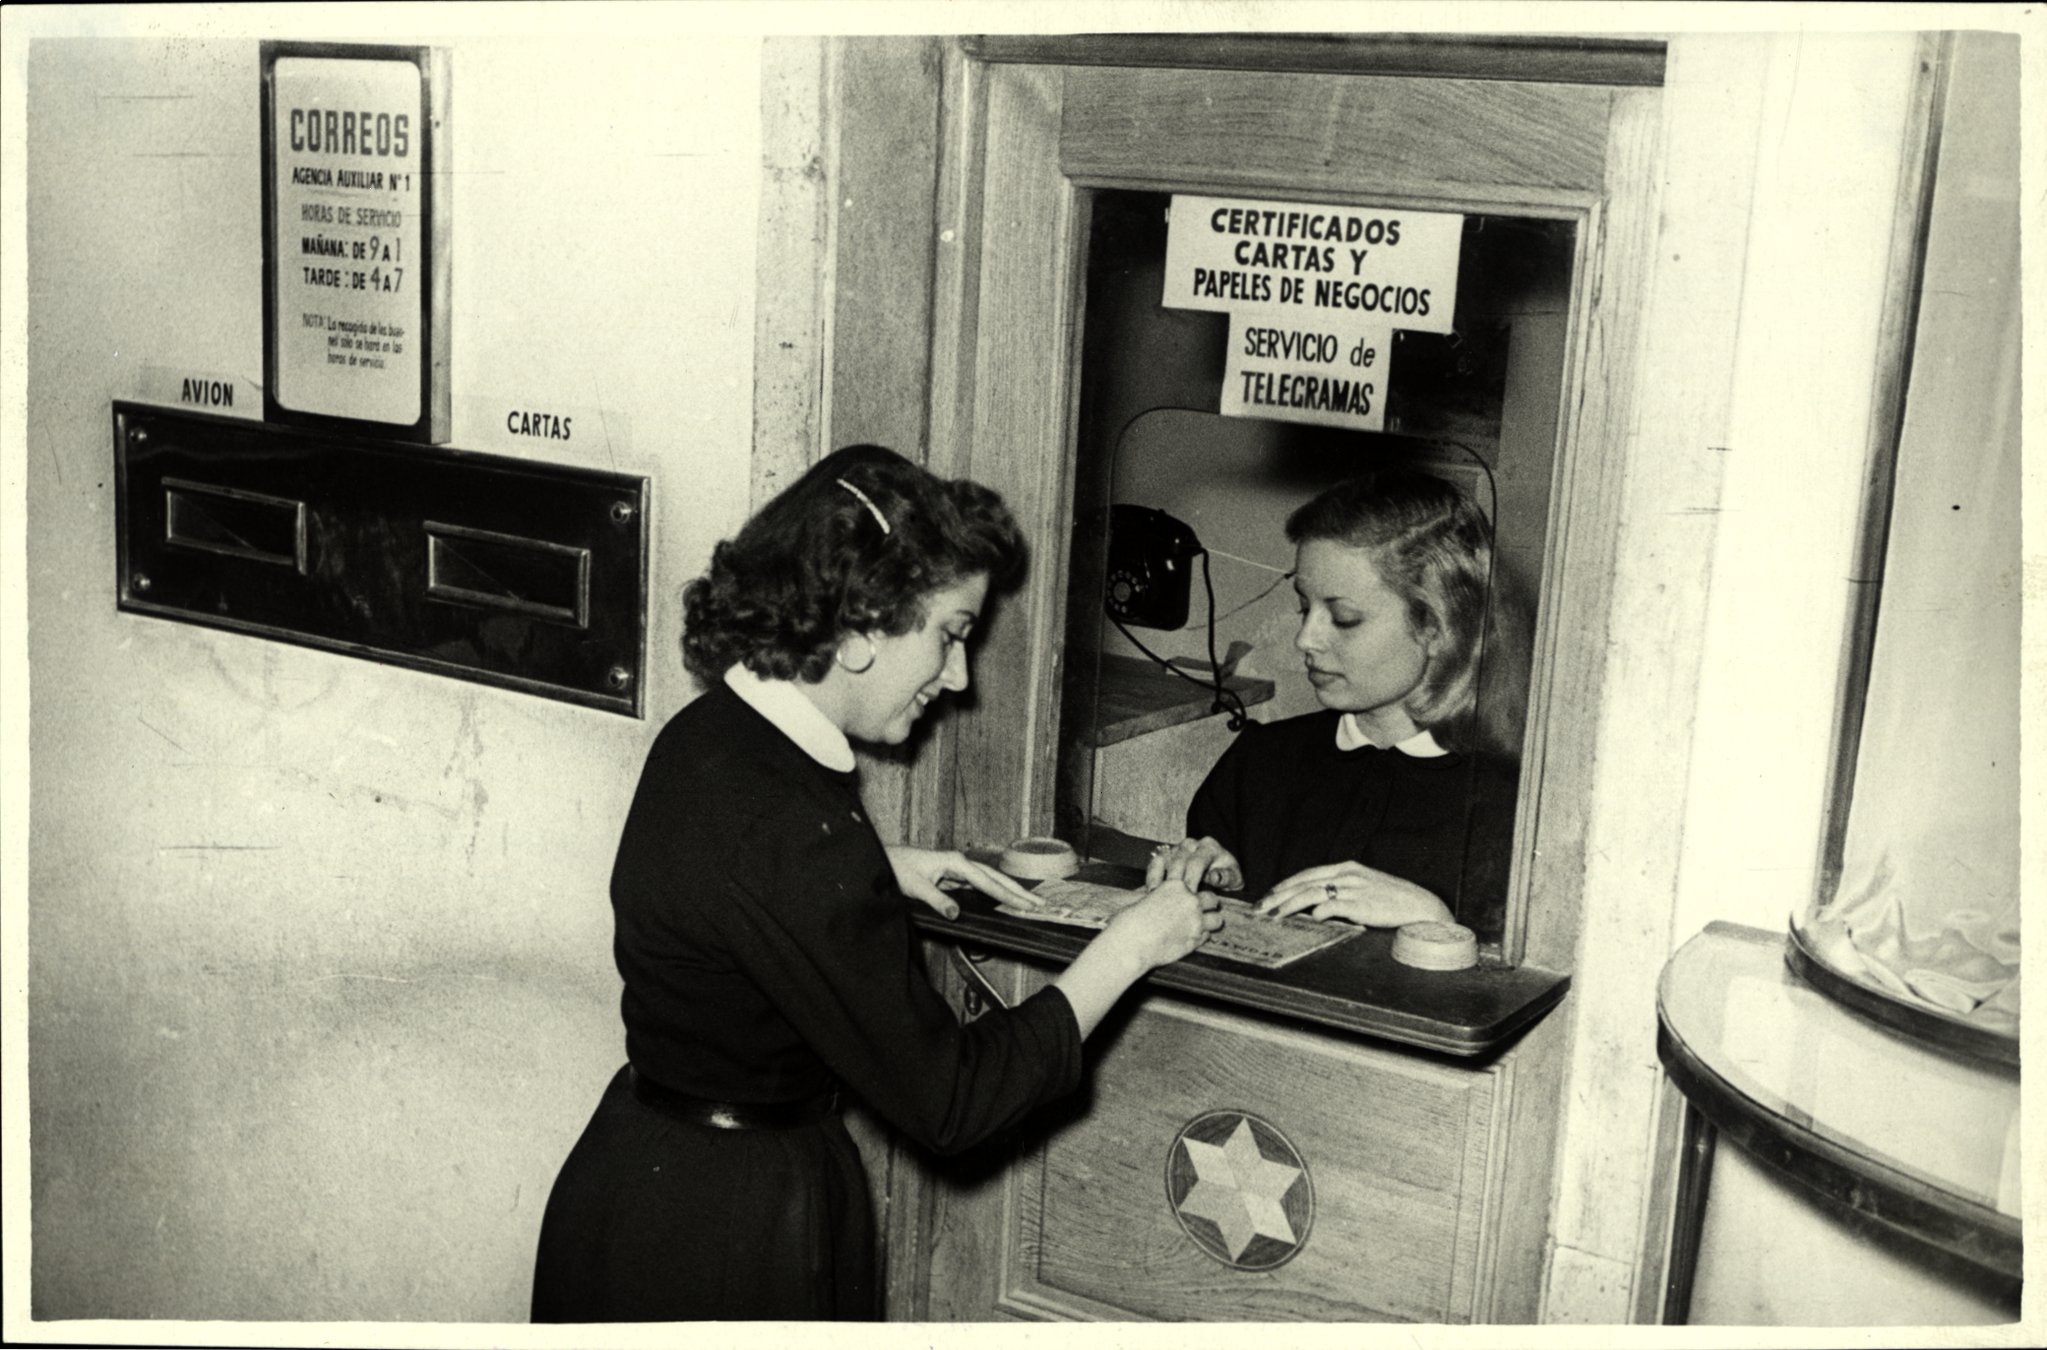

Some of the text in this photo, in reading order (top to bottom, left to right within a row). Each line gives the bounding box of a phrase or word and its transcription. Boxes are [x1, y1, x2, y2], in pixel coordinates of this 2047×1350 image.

[290, 108, 409, 157] CORREOS
[292, 167, 333, 186] AGENCIA
[337, 169, 383, 189] AUXILIAR
[405, 174, 409, 191] 1
[301, 204, 401, 227] HORAS DE SERVICIO
[1211, 208, 1401, 246] CERTIFICADOS
[302, 233, 400, 262] MAÑANA: DE 9 A 1
[1234, 240, 1368, 275] CARTAS Y
[303, 267, 340, 287] TARDE
[352, 272, 365, 290] DE
[370, 266, 381, 291] 4
[383, 275, 391, 292] A
[394, 267, 403, 292] 7
[1193, 268, 1431, 316] PAPELES DE NEGOCIOS
[328, 316, 336, 331] La
[328, 350, 346, 364] horas
[349, 353, 357, 366] de
[356, 339, 363, 350] se
[382, 343, 390, 352] en
[1244, 327, 1375, 367] SERVICIO de
[182, 377, 233, 407] AVION
[1241, 370, 1373, 416] TELEGRAMAS
[507, 411, 572, 441] CARTAS
